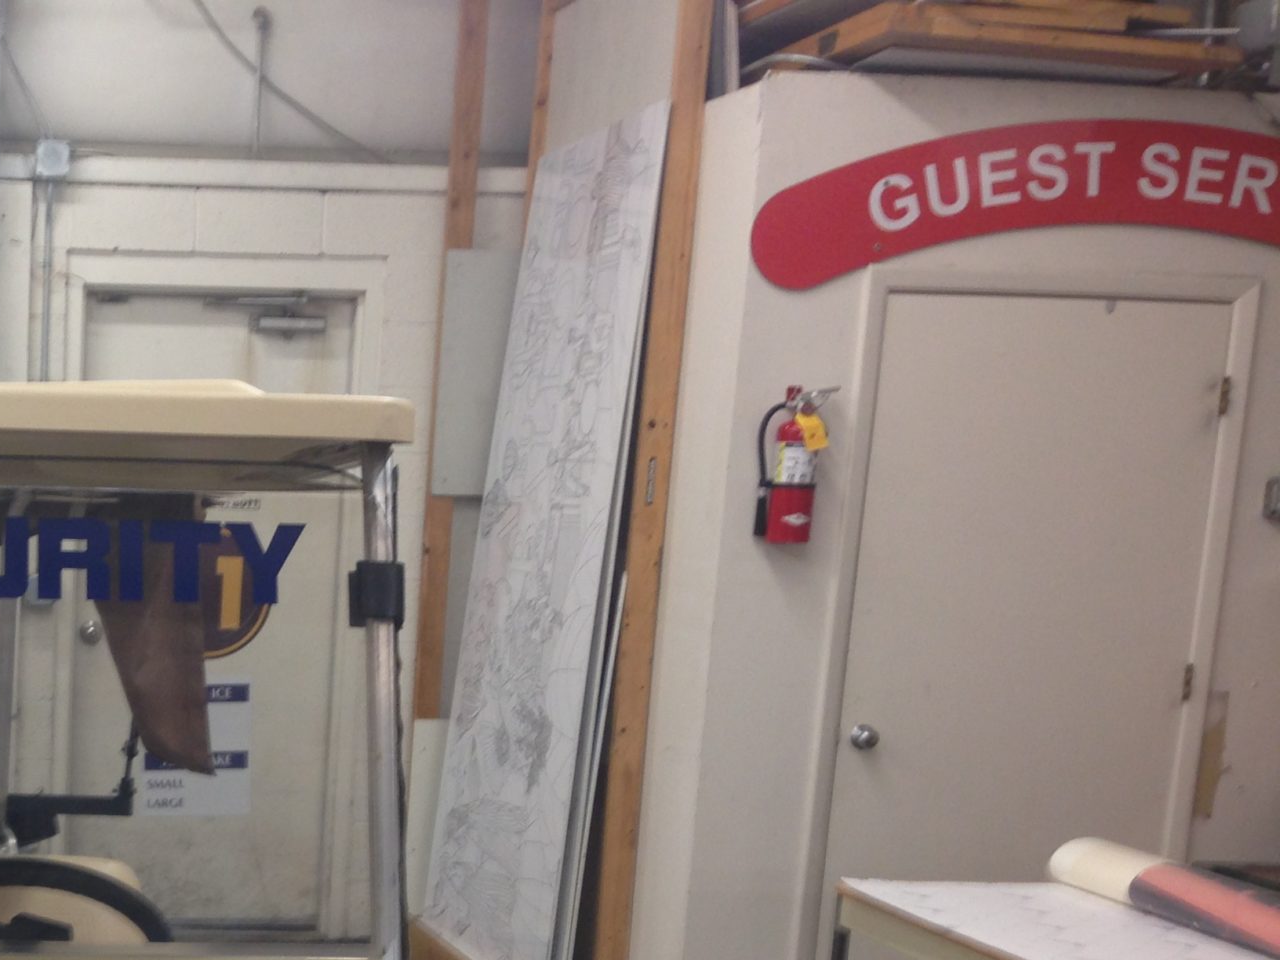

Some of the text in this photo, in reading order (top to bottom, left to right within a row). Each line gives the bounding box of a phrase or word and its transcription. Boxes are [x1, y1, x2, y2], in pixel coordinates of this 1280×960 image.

[868, 141, 1280, 232] GUEST SER
[146, 777, 184, 790] SMALL
[146, 797, 184, 810] LARGE
